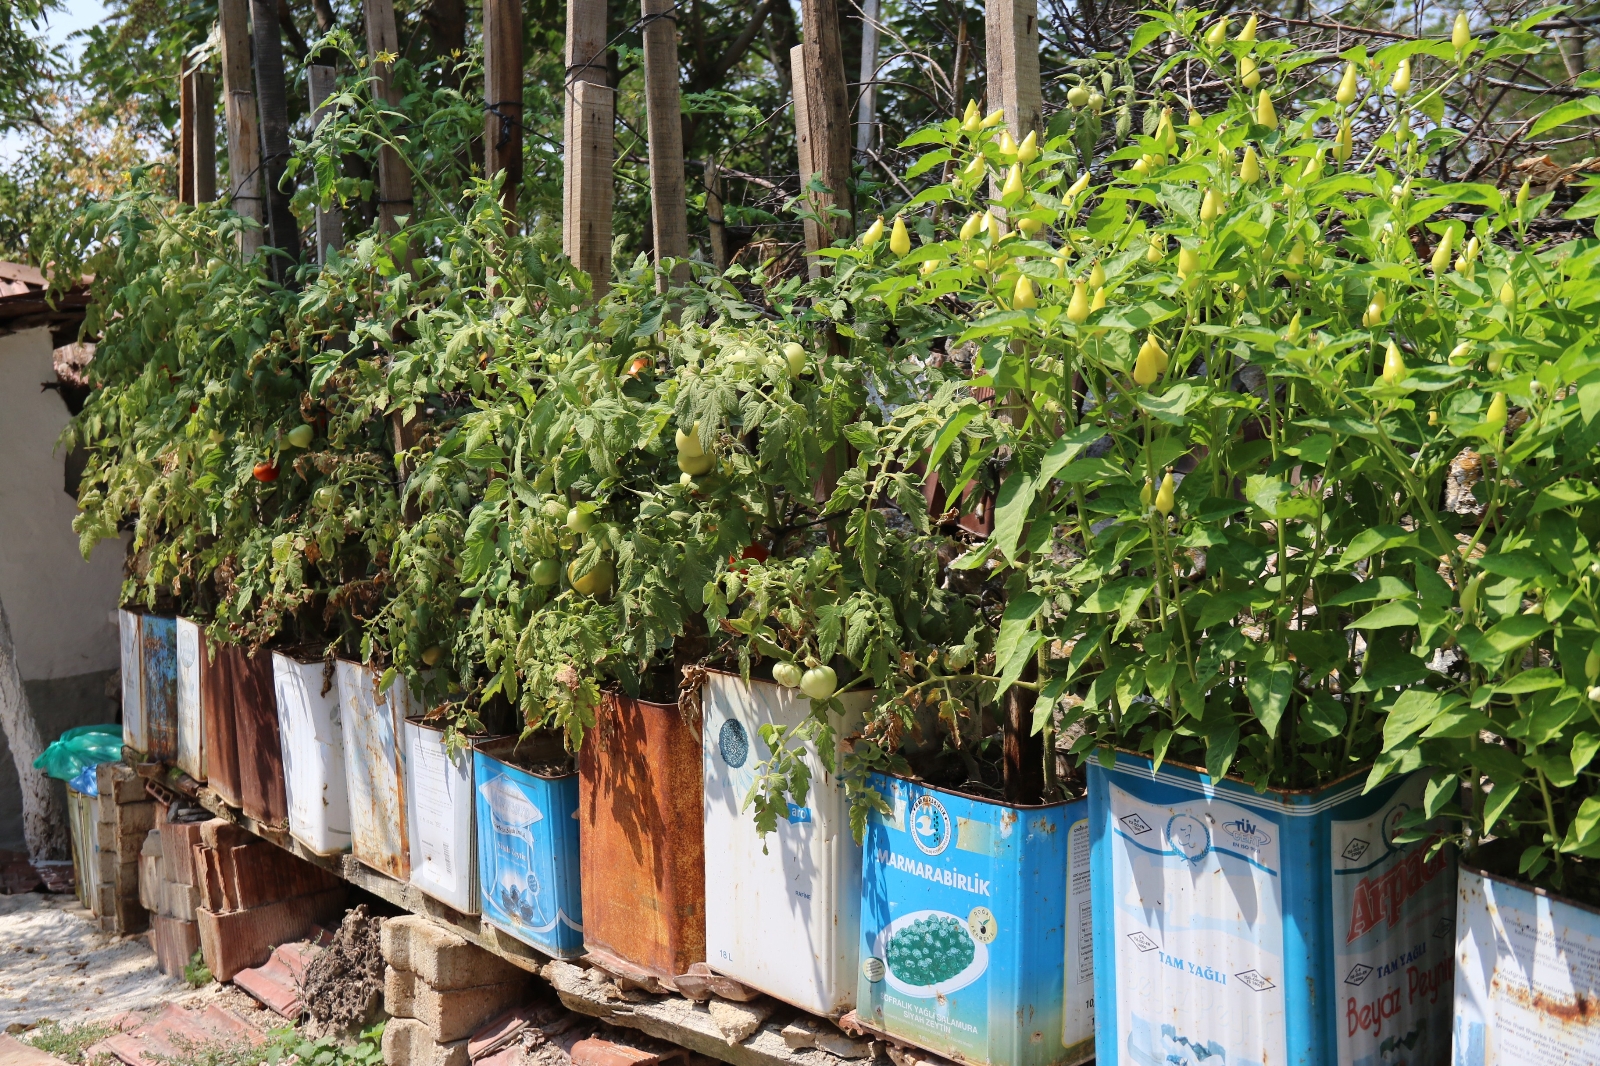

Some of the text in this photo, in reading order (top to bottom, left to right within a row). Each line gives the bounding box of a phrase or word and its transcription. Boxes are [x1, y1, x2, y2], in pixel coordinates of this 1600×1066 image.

[791, 807, 806, 819] aro
[1235, 818, 1256, 834] TÜV
[1232, 830, 1262, 847] CERT
[876, 848, 990, 897] MARMARABİRLİK
[720, 949, 733, 962] 18 L
[1158, 951, 1227, 986] TAM YAĞLI
[1376, 942, 1426, 979] TAM YAĞLI
[1346, 950, 1455, 1038] Beyaz Peynir
[880, 992, 912, 1010] SOFRALIK
[936, 1014, 978, 1034] SALAMURA
[926, 1018, 951, 1034] ZEYTİN
